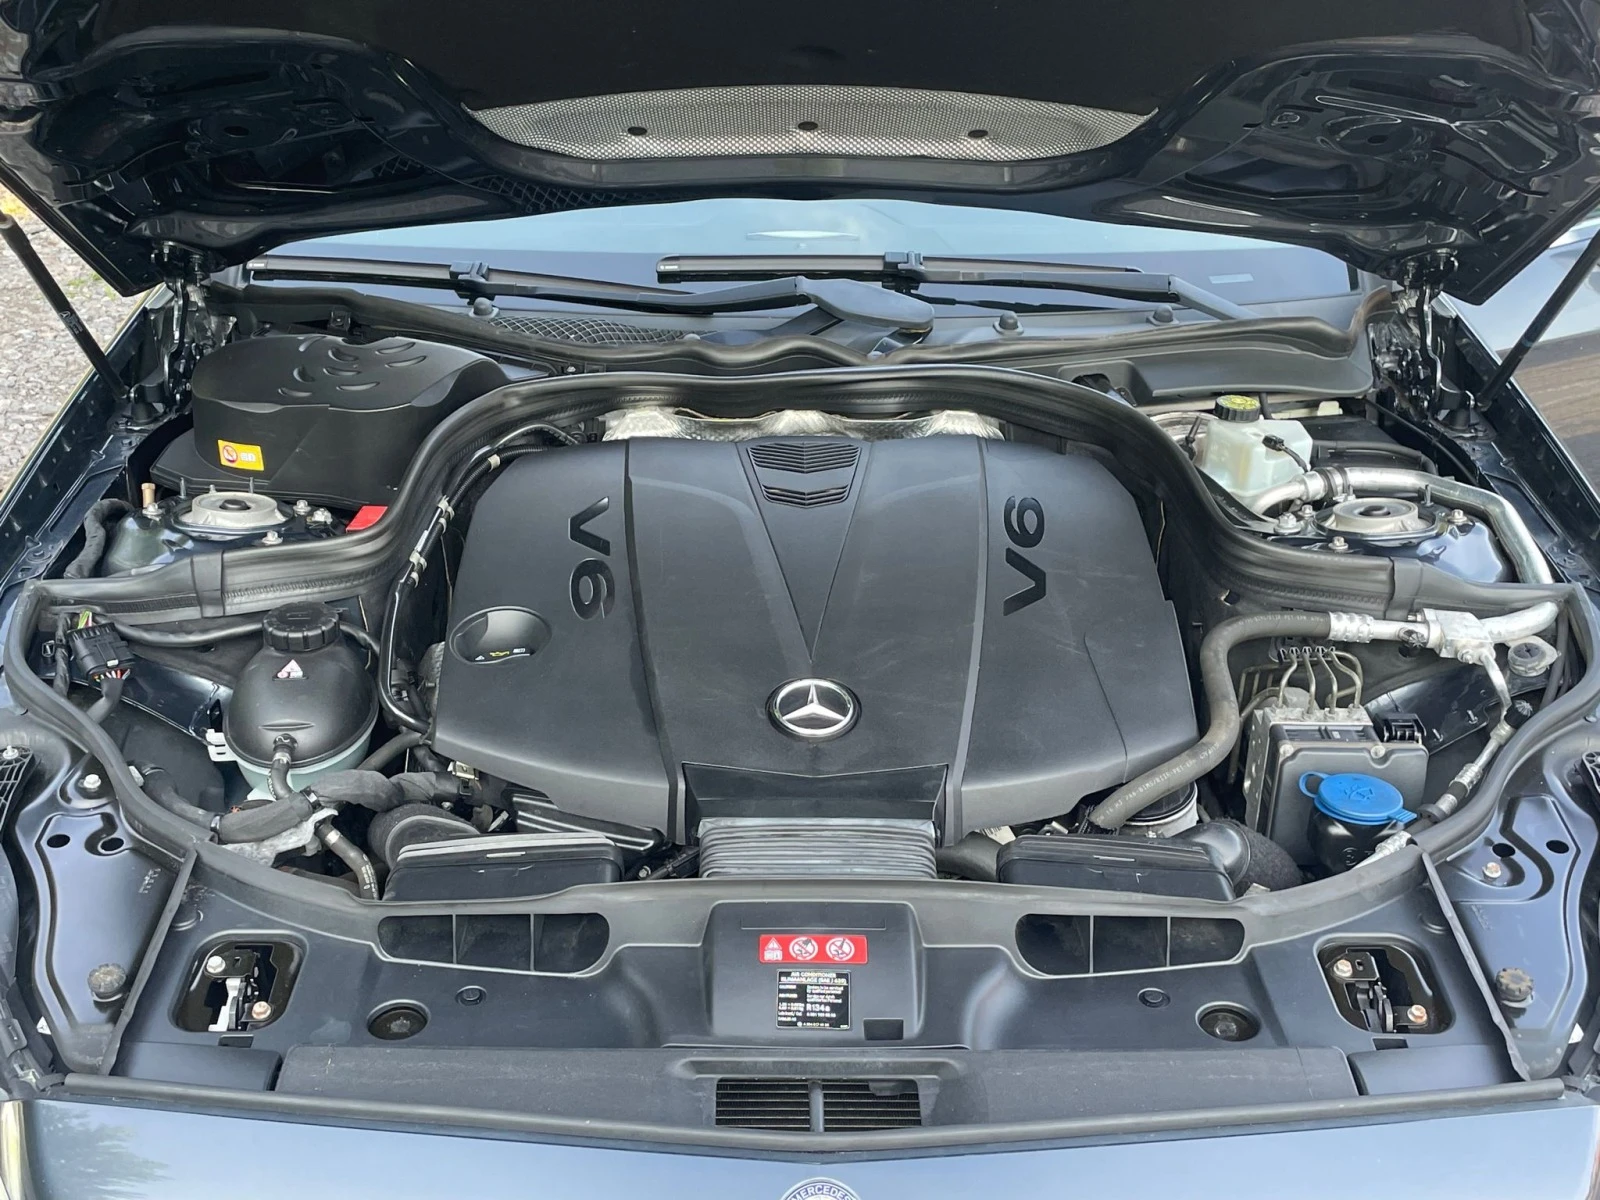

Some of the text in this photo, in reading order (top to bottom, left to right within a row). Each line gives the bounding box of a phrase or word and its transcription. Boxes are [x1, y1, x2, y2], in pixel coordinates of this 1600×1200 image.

[568, 496, 615, 620] V6
[1003, 495, 1046, 616] V6
[789, 1185, 851, 1200] MERCEDES
